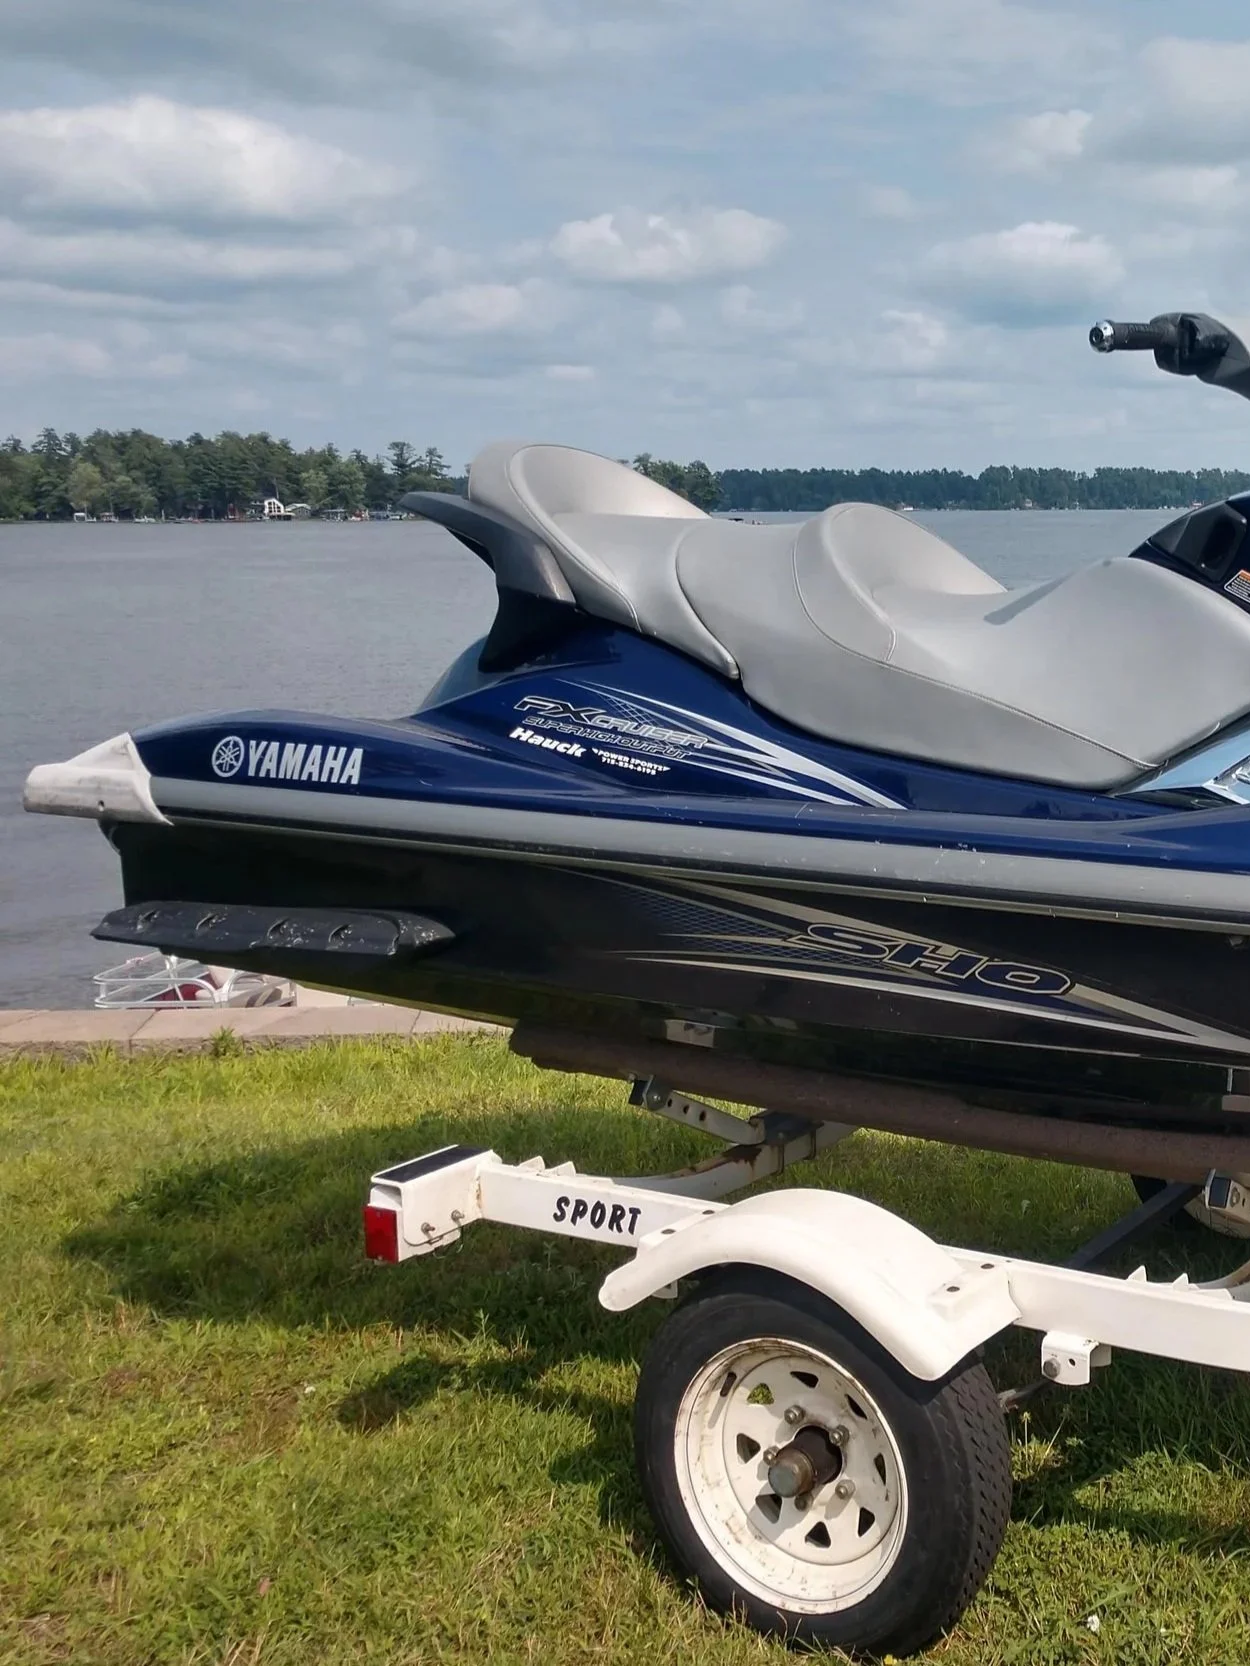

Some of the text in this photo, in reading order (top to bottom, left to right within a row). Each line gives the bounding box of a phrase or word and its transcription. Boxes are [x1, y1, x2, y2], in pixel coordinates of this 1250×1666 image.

[513, 695, 709, 749] FX CRUISER
[522, 715, 582, 737] SUPER
[248, 740, 364, 785] YAMAHA
[509, 727, 587, 758] Hauck
[597, 749, 664, 772] POWER SPORTS
[784, 923, 1072, 995] SHO
[553, 1196, 642, 1236] SPORT
